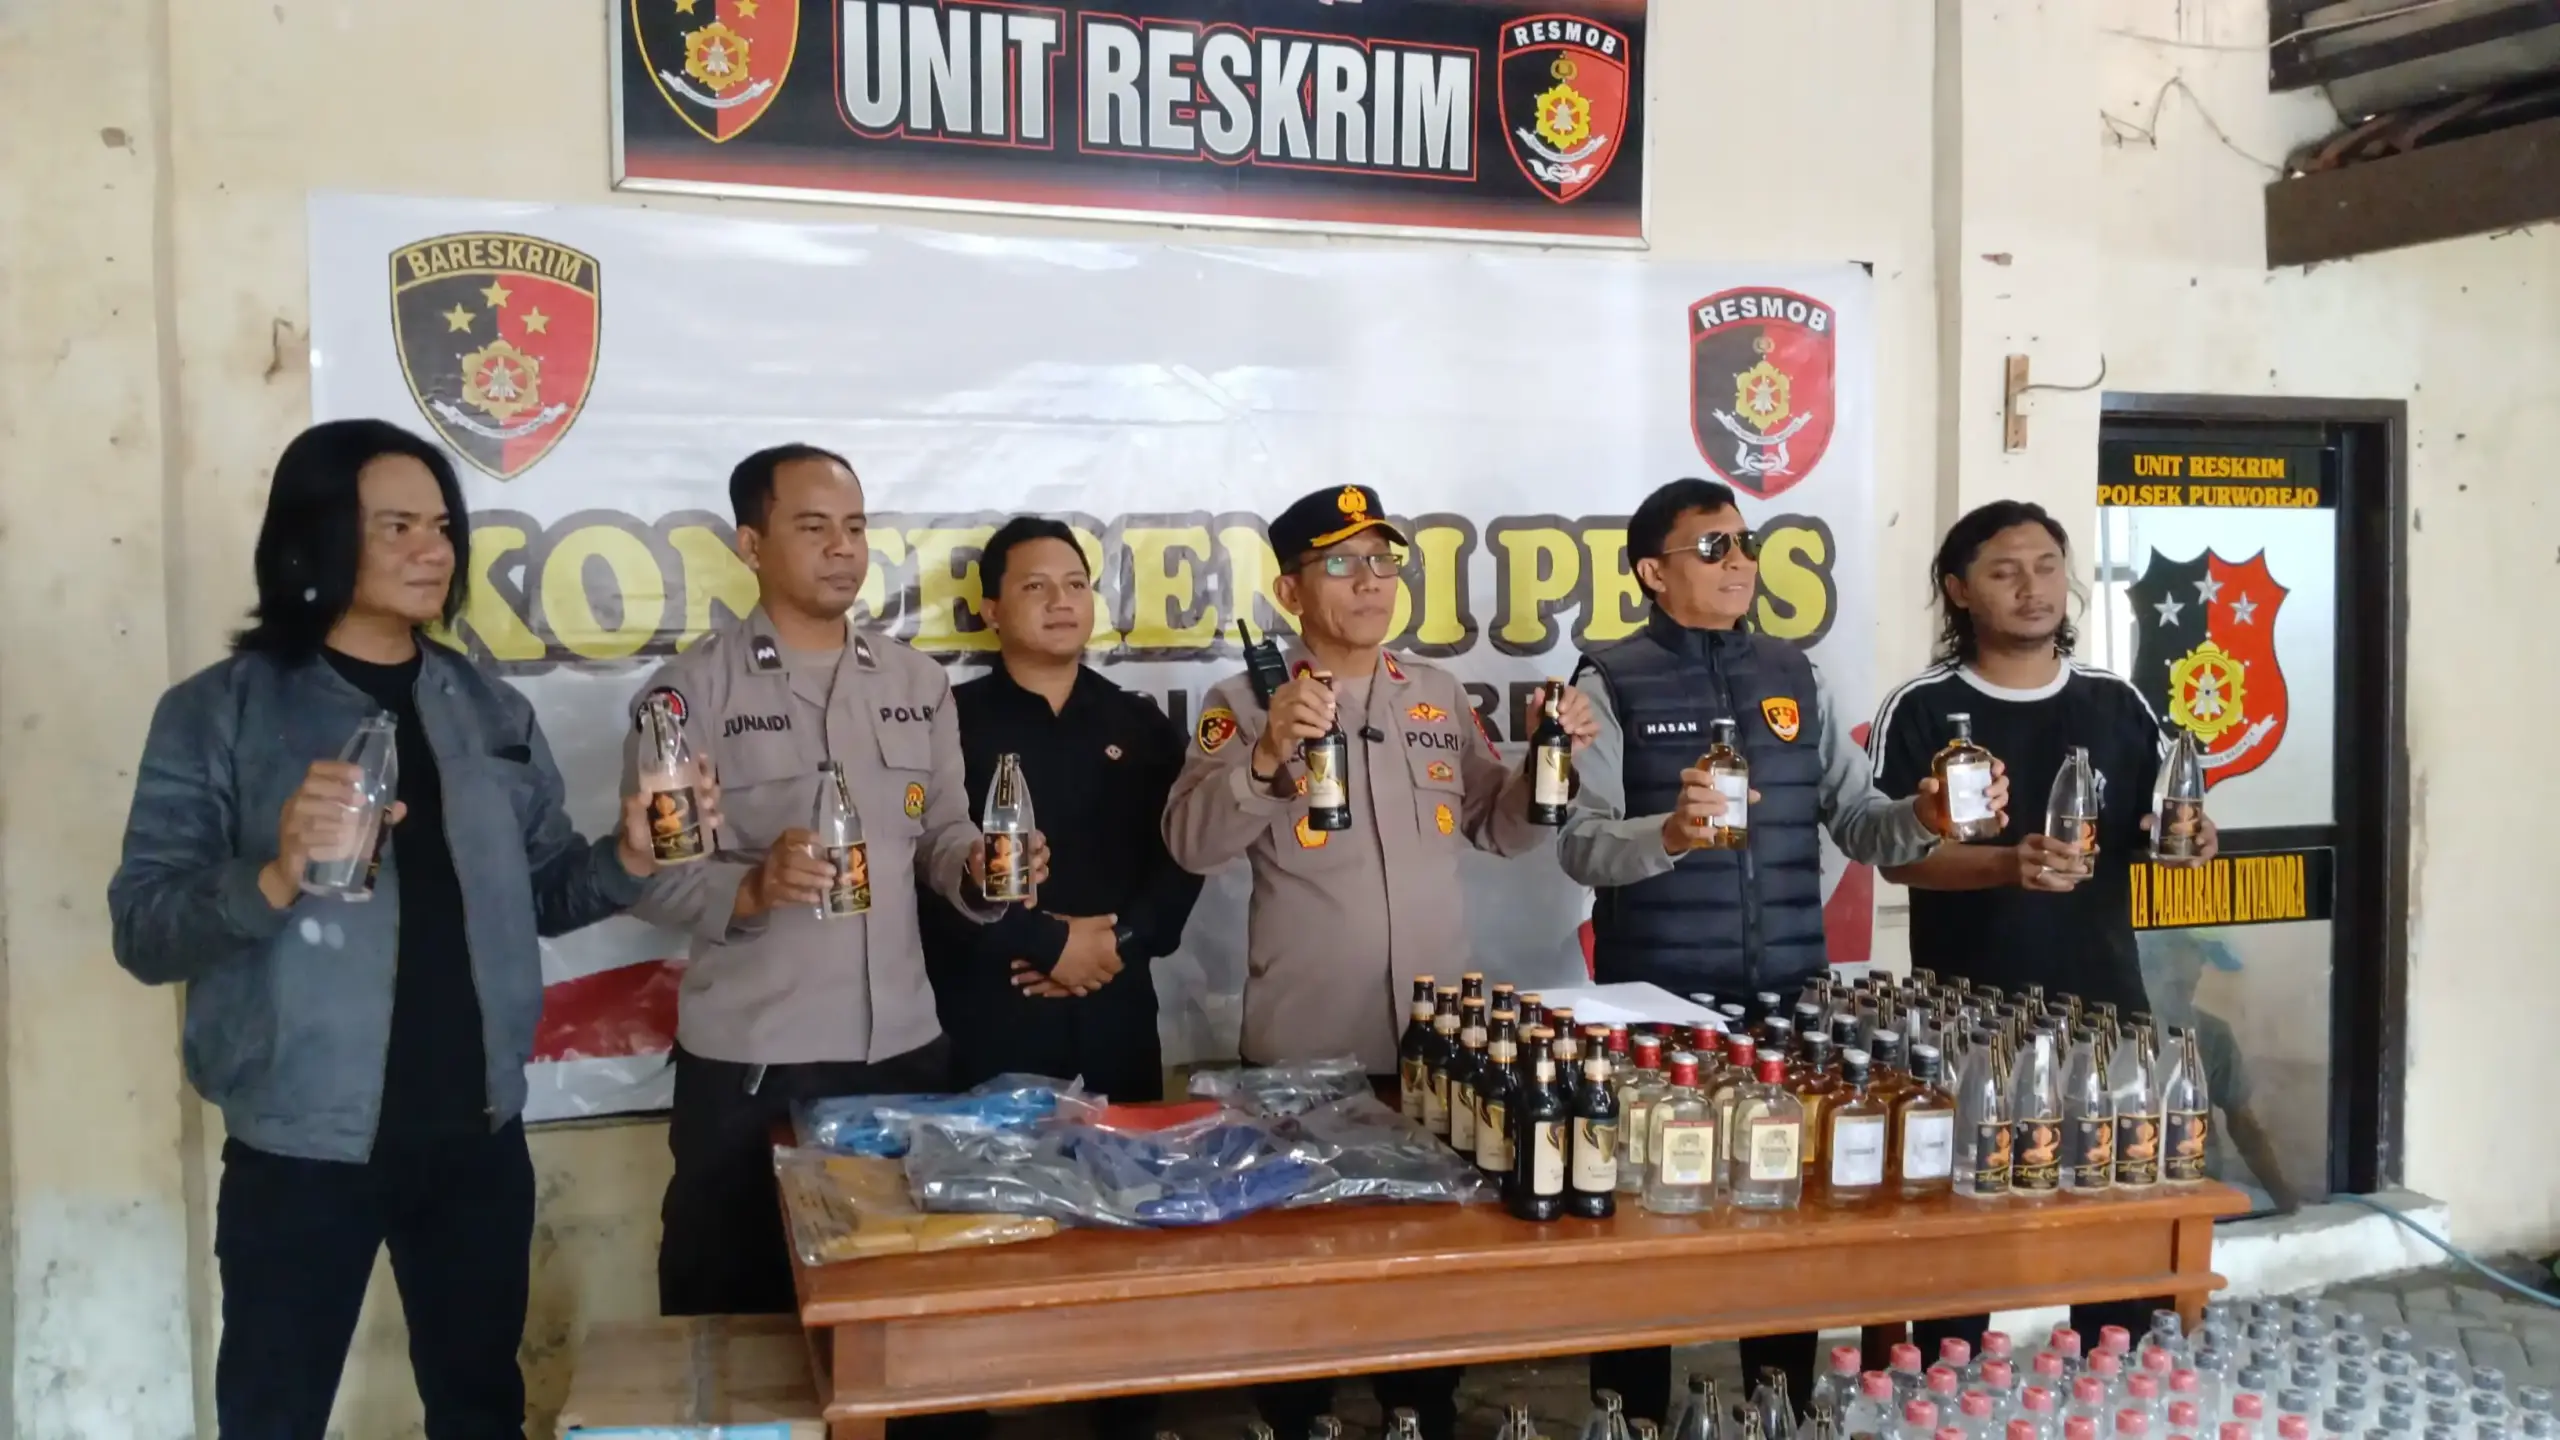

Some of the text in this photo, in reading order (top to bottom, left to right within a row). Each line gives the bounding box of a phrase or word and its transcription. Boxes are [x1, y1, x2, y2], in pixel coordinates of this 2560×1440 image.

[1513, 20, 1617, 54] RESMOB
[841, 0, 1474, 173] UNIT RESKRIM
[405, 239, 583, 283] BARESKRIM
[1698, 296, 1828, 332] RESMOB
[2134, 455, 2285, 479] UNIT RESKRIM
[2097, 485, 2319, 508] POLSEK PURWOREJO
[1499, 526, 1827, 643] PES
[723, 714, 791, 737] JUNAIDI
[879, 705, 936, 723] POLR
[1647, 722, 1697, 735] HASAN
[1405, 731, 1459, 752] POLRI
